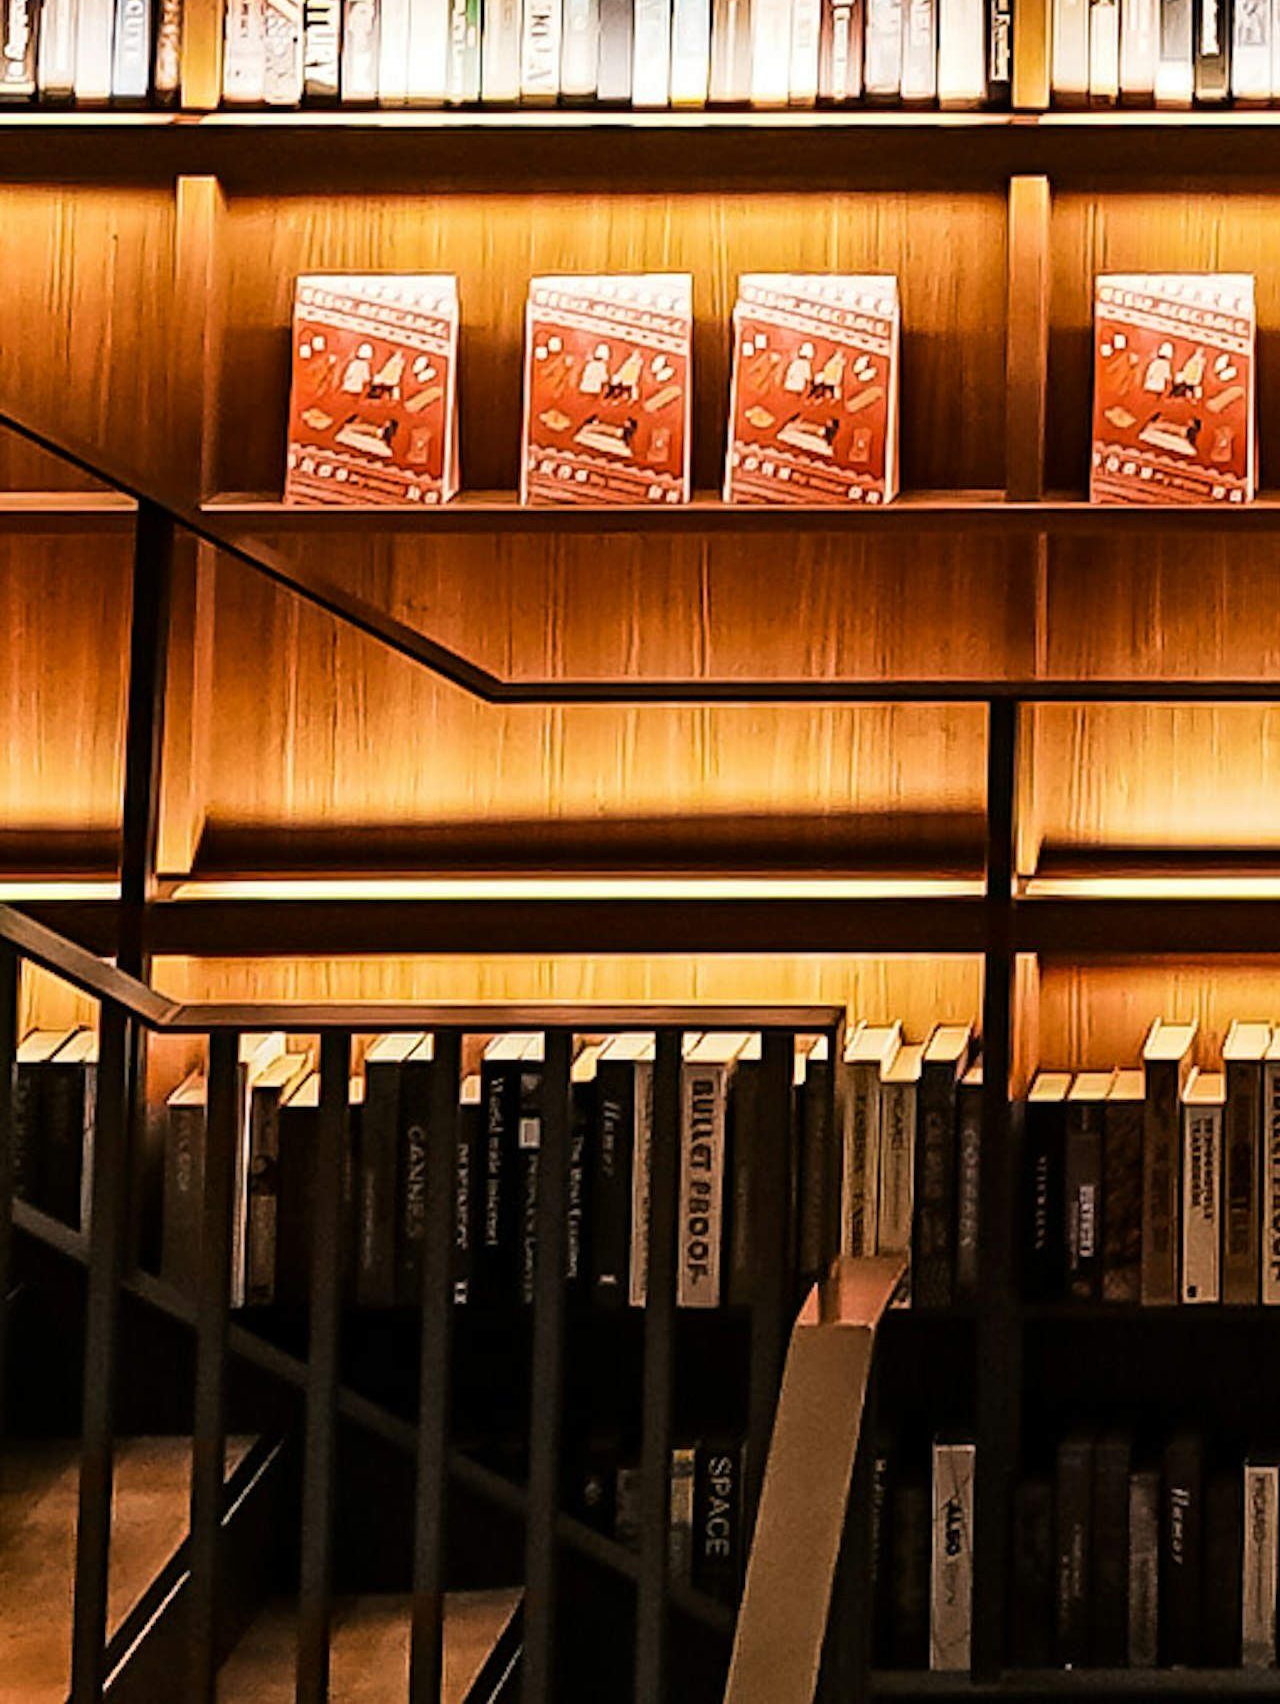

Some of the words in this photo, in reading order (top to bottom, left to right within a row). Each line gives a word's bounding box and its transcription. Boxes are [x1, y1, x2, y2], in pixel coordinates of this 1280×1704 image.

[689, 1079, 714, 1172] BULLET
[405, 1125, 425, 1239] CANNES
[705, 1457, 731, 1556] SPACE
